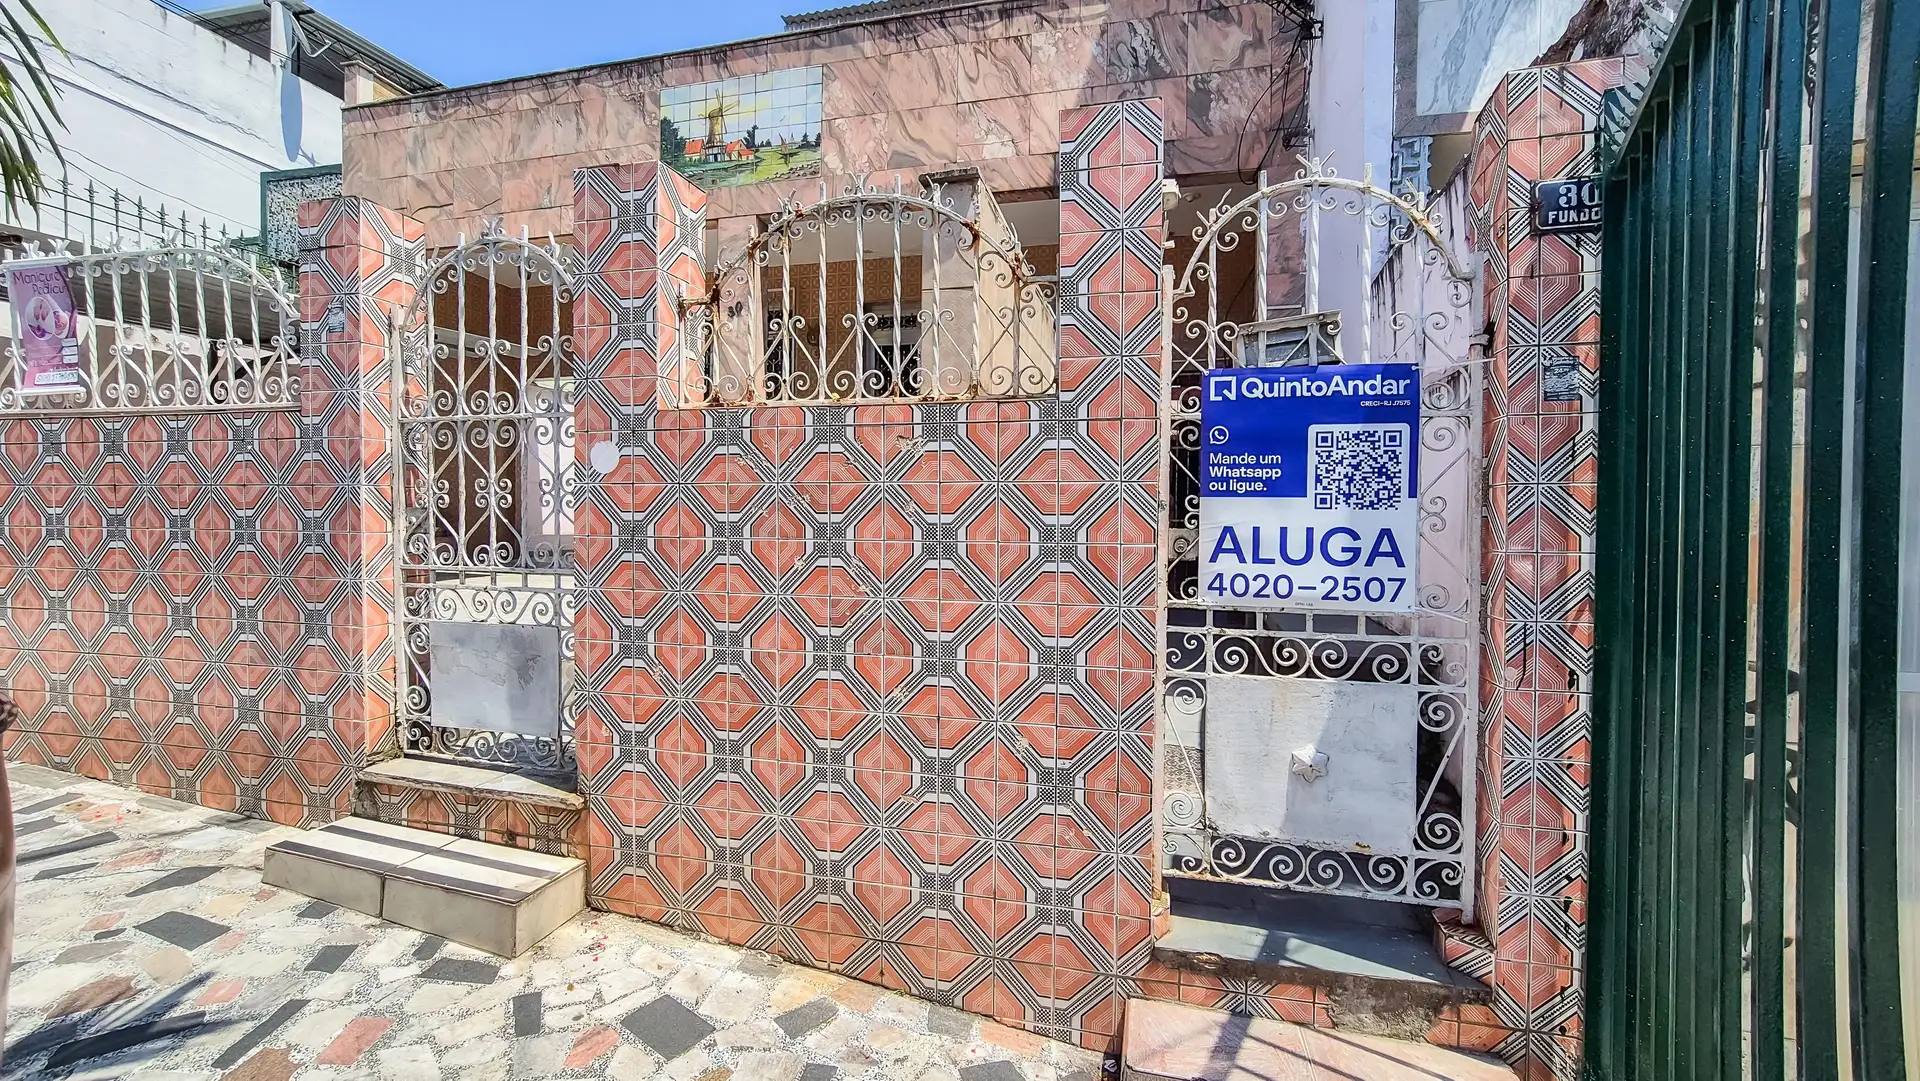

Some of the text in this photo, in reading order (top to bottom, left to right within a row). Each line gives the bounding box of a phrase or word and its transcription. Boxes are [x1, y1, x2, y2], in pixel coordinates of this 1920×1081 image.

[1241, 374, 1410, 399] QuintoAndar
[1209, 453, 1281, 465] Mande um
[1209, 466, 1282, 480] Whatsapp
[1209, 479, 1267, 494] ou ligue.
[1208, 526, 1406, 568] ALUGA
[1207, 572, 1407, 603] 4020-2507
